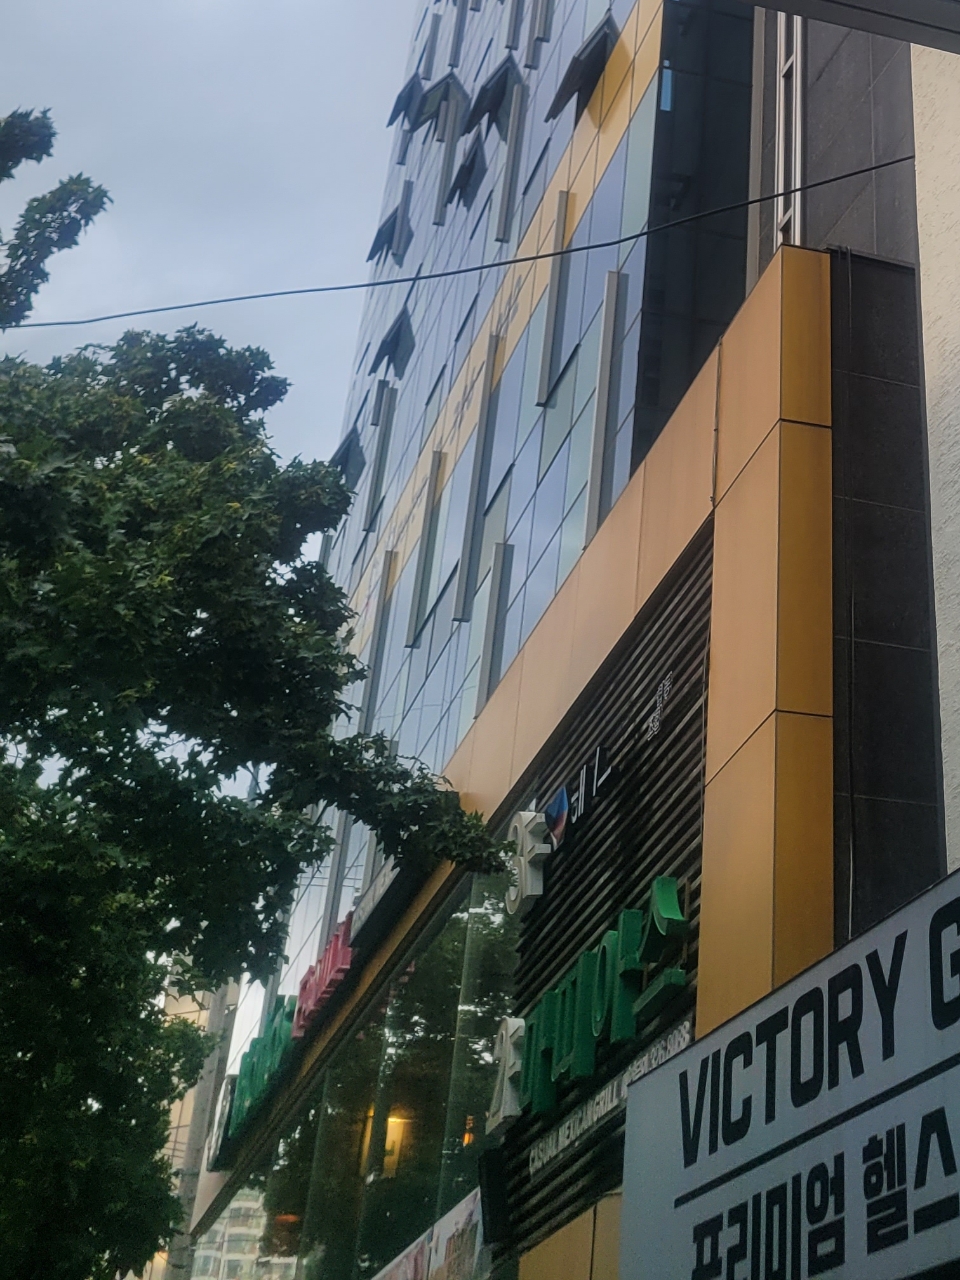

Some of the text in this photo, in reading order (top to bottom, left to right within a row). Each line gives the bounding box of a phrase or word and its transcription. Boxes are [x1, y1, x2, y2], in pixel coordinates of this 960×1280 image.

[505, 811, 551, 914] 3F
[593, 1081, 619, 1117] GRILL
[679, 929, 907, 1168] VICTORY
[691, 1151, 846, 1280] 프리미엄
